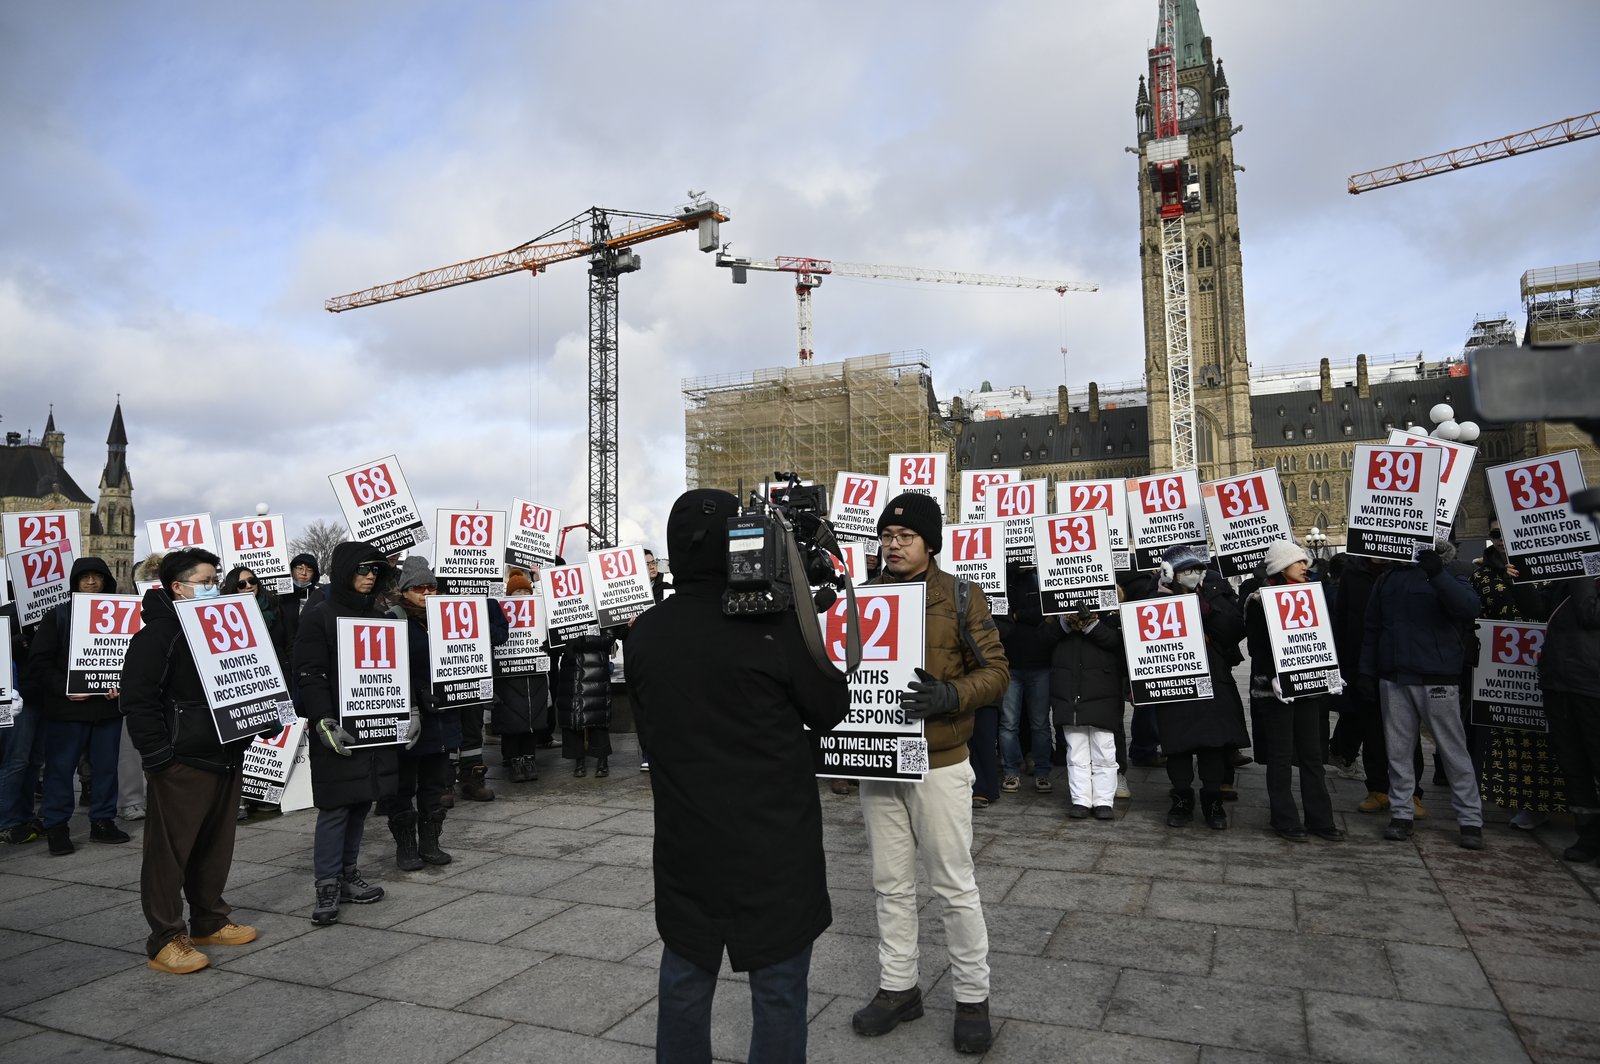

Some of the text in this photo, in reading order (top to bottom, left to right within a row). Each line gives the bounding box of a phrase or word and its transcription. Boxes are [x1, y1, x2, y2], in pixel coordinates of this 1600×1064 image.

[903, 458, 931, 485] 34
[1372, 451, 1416, 491] 39
[353, 466, 391, 504] 68
[848, 478, 874, 506] 72
[1512, 463, 1560, 509] 33
[1000, 485, 1031, 516] 40
[1074, 485, 1108, 512] 22
[1145, 478, 1182, 512] 46
[1223, 479, 1264, 516] 31
[1371, 495, 1413, 507] MONTHS
[363, 499, 396, 517] MONTHS
[844, 507, 870, 516] MONTHS
[1361, 505, 1423, 519] WAITING FOR
[358, 505, 408, 528] WAITING FOR
[523, 504, 549, 532] 30
[837, 514, 875, 525] WAITING FOR
[1149, 513, 1185, 525] MONTHS
[1229, 515, 1267, 530] MONTHS
[1521, 509, 1566, 525] MONTHS
[357, 512, 416, 540] IRCC RESPONSE
[455, 515, 488, 546] 68
[845, 523, 877, 534] RESPONSE
[1142, 521, 1195, 535] WAITING FOR
[1354, 516, 1429, 532] IRCC RESPONSE
[1513, 520, 1582, 539] WAITING FOR
[24, 516, 62, 547] 25
[165, 520, 195, 548] 27
[238, 521, 268, 550] 19
[521, 529, 546, 541] MONTHS
[1054, 517, 1091, 553] 53
[1138, 535, 1157, 545] IRCC
[1157, 529, 1201, 543] RESPONSE
[1222, 523, 1280, 542] WAITING FOR
[386, 536, 413, 551] RESULTS
[515, 534, 551, 549] WAITING FOR
[957, 528, 987, 560] 71
[1220, 532, 1287, 552] IRCC RESPONSE
[1361, 533, 1417, 546] NO TIMELINES
[1510, 531, 1592, 551] IRCC RESPONSE
[453, 549, 487, 557] MONTHS
[523, 544, 553, 557] RESPONSE
[1364, 542, 1412, 555] NO RESULTS
[239, 551, 272, 561] MONTHS
[266, 557, 281, 567] FOR
[444, 557, 495, 566] WAITING FOR
[1055, 555, 1093, 566] MONTHS
[1231, 555, 1243, 564] NO
[1524, 550, 1584, 566] NO TIMELINES
[27, 549, 61, 587] 22
[439, 566, 499, 575] IRCC RESPONSE
[603, 550, 633, 579] 30
[956, 563, 988, 572] MONTHS
[1048, 563, 1103, 577] WAITING FOR
[1237, 562, 1248, 571] NO
[1531, 561, 1583, 575] NO RESULTS
[554, 568, 581, 597] 30
[981, 572, 996, 580] FOR
[1044, 573, 1110, 588] IRCC RESPONSE
[607, 578, 636, 589] MONTHS
[32, 583, 63, 599] MONTHS
[602, 585, 644, 599] WAITING FOR
[615, 592, 650, 604] RESPONSE
[26, 595, 57, 611] WAITING
[557, 597, 583, 607] MONTHS
[24, 610, 41, 622] IRCC
[503, 600, 532, 628] 34
[552, 604, 578, 617] WAITING
[1281, 590, 1314, 629] 23
[95, 600, 137, 634] 37
[445, 602, 473, 639] 19
[564, 611, 594, 623] RESPONSE
[1141, 602, 1182, 640] 34
[204, 603, 249, 652] 39
[1287, 631, 1318, 644] MONTHS
[82, 648, 124, 657] WAITING
[360, 626, 391, 668] 11
[446, 643, 476, 654] MONTHS
[1146, 642, 1184, 654] MONTHS
[1281, 642, 1327, 656] WAITING FOR
[1498, 627, 1545, 666] 33
[76, 658, 98, 667] IRCC
[219, 653, 258, 671] MONTHS
[440, 653, 484, 666] WAITING FOR
[1138, 651, 1196, 666] WAITING FOR
[1280, 652, 1333, 668] IRCC RESPONSE
[214, 665, 272, 687] WAITING FOR
[436, 664, 488, 678] IRCC RESPONSE
[1134, 661, 1203, 677] IRCC RESPONSE
[359, 673, 393, 684] MONTHS
[1145, 678, 1196, 690] NO TIMELINES
[1289, 674, 1299, 682] NO
[1294, 679, 1328, 691] NO RESULTS
[1485, 678, 1531, 691] WAITING
[213, 677, 281, 702] IRCC RESPONSE
[351, 686, 401, 698] WAITING FOR
[1149, 686, 1194, 698] NO RESULTS
[1479, 688, 1502, 699] IRCC
[346, 698, 406, 712] IRCC RESPONSE
[1488, 705, 1501, 713] NO
[228, 708, 242, 720] NO
[235, 710, 279, 731] NO RESULTS
[1492, 714, 1546, 727] NO RESULTS
[355, 719, 365, 729] NO
[358, 727, 397, 739] NO RESULTS
[820, 736, 898, 752] NO TIMELINES
[266, 759, 283, 769] FOR
[824, 752, 893, 768] NO RESULTS
